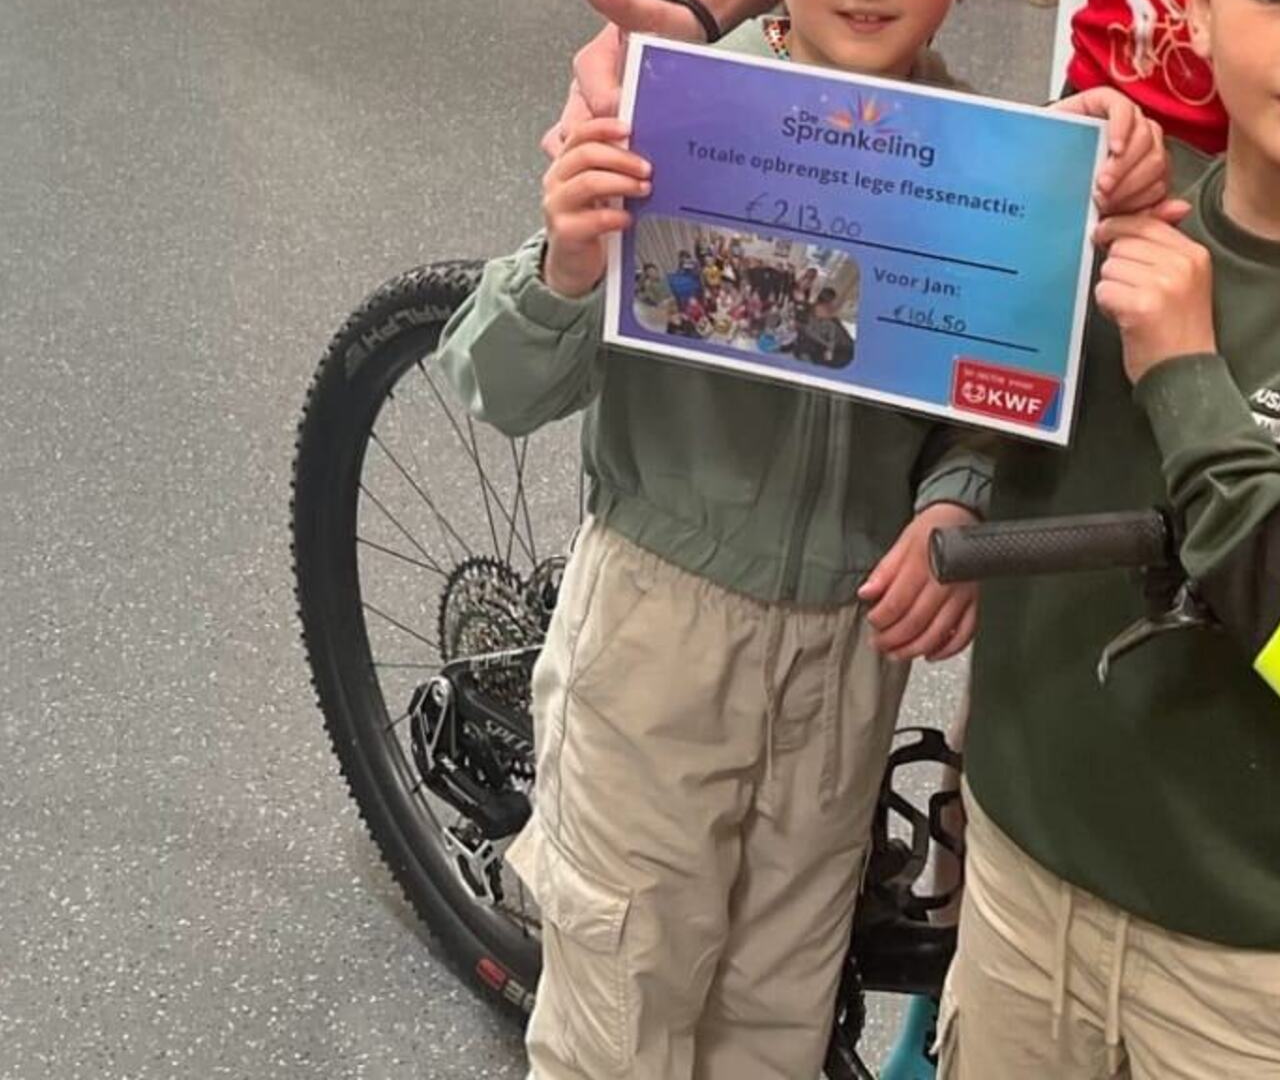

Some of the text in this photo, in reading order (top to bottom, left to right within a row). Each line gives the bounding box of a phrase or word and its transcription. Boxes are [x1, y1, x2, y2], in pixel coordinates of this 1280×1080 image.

[781, 116, 935, 168] Sprankeling
[687, 140, 1026, 218] Totale opbrengst lege flessenactie:
[873, 267, 962, 298] Voor Jan:
[987, 388, 1043, 415] KWF
